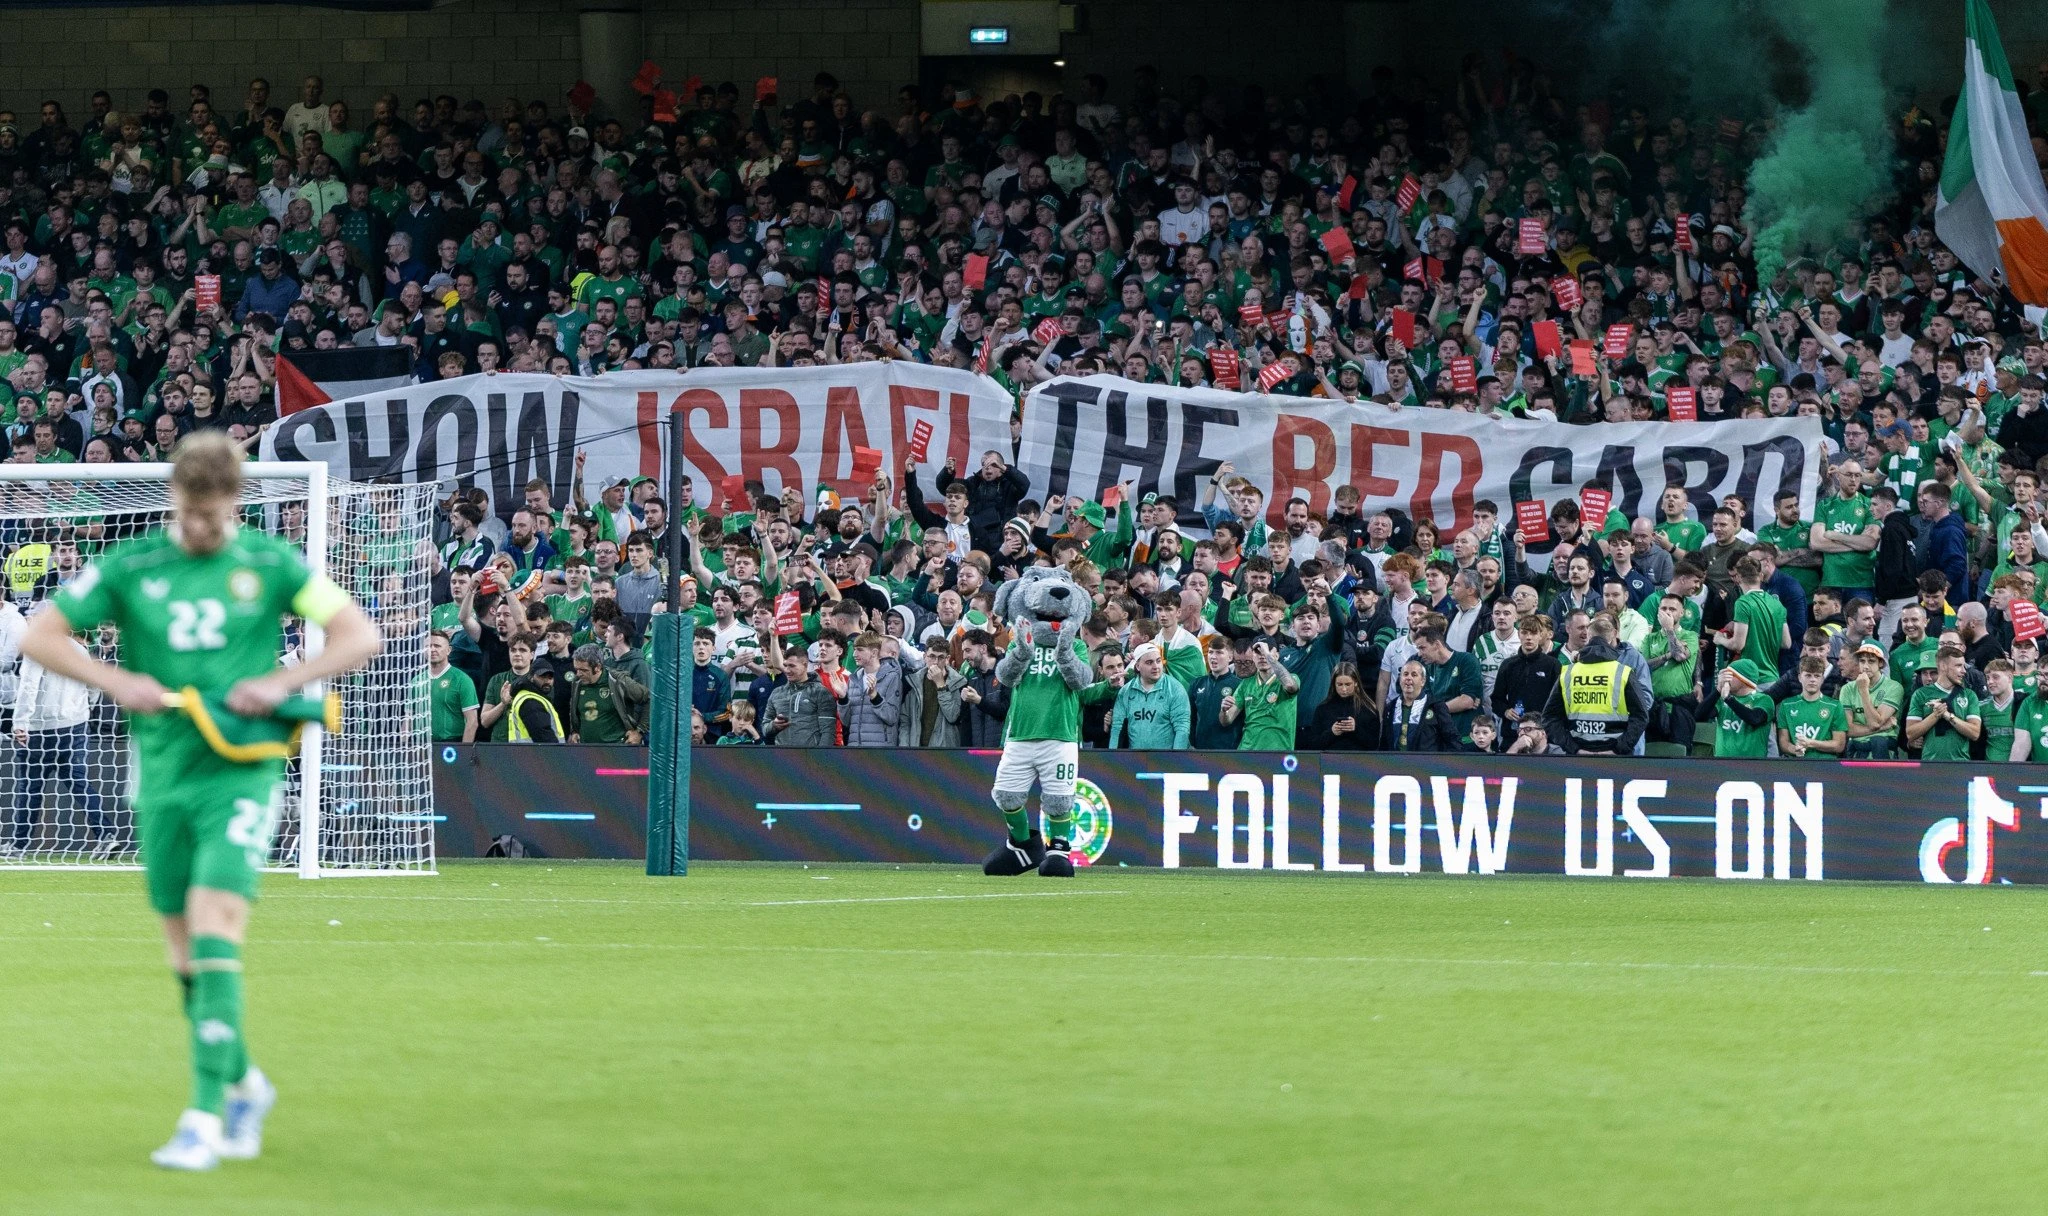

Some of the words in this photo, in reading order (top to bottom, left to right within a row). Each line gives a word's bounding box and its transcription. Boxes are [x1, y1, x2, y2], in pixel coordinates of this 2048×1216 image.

[274, 391, 579, 515] SHOW
[1040, 381, 1239, 525] THE
[1265, 414, 1482, 545] RED
[1505, 435, 1806, 553] CARD
[1833, 520, 1857, 535] sky
[15, 558, 43, 568] PULSE
[166, 597, 227, 652] 22
[1034, 647, 1055, 662] 88
[1030, 661, 1056, 677] sky
[1573, 676, 1609, 686] PULSE
[1573, 692, 1608, 705] SECURITY
[1134, 708, 1157, 723] sky
[1576, 721, 1606, 734] SG132
[1795, 722, 1820, 740] sky
[1056, 763, 1075, 780] 88
[1163, 773, 1519, 875] FOLLOW
[1565, 778, 1671, 878] US
[1715, 781, 1823, 880] ON
